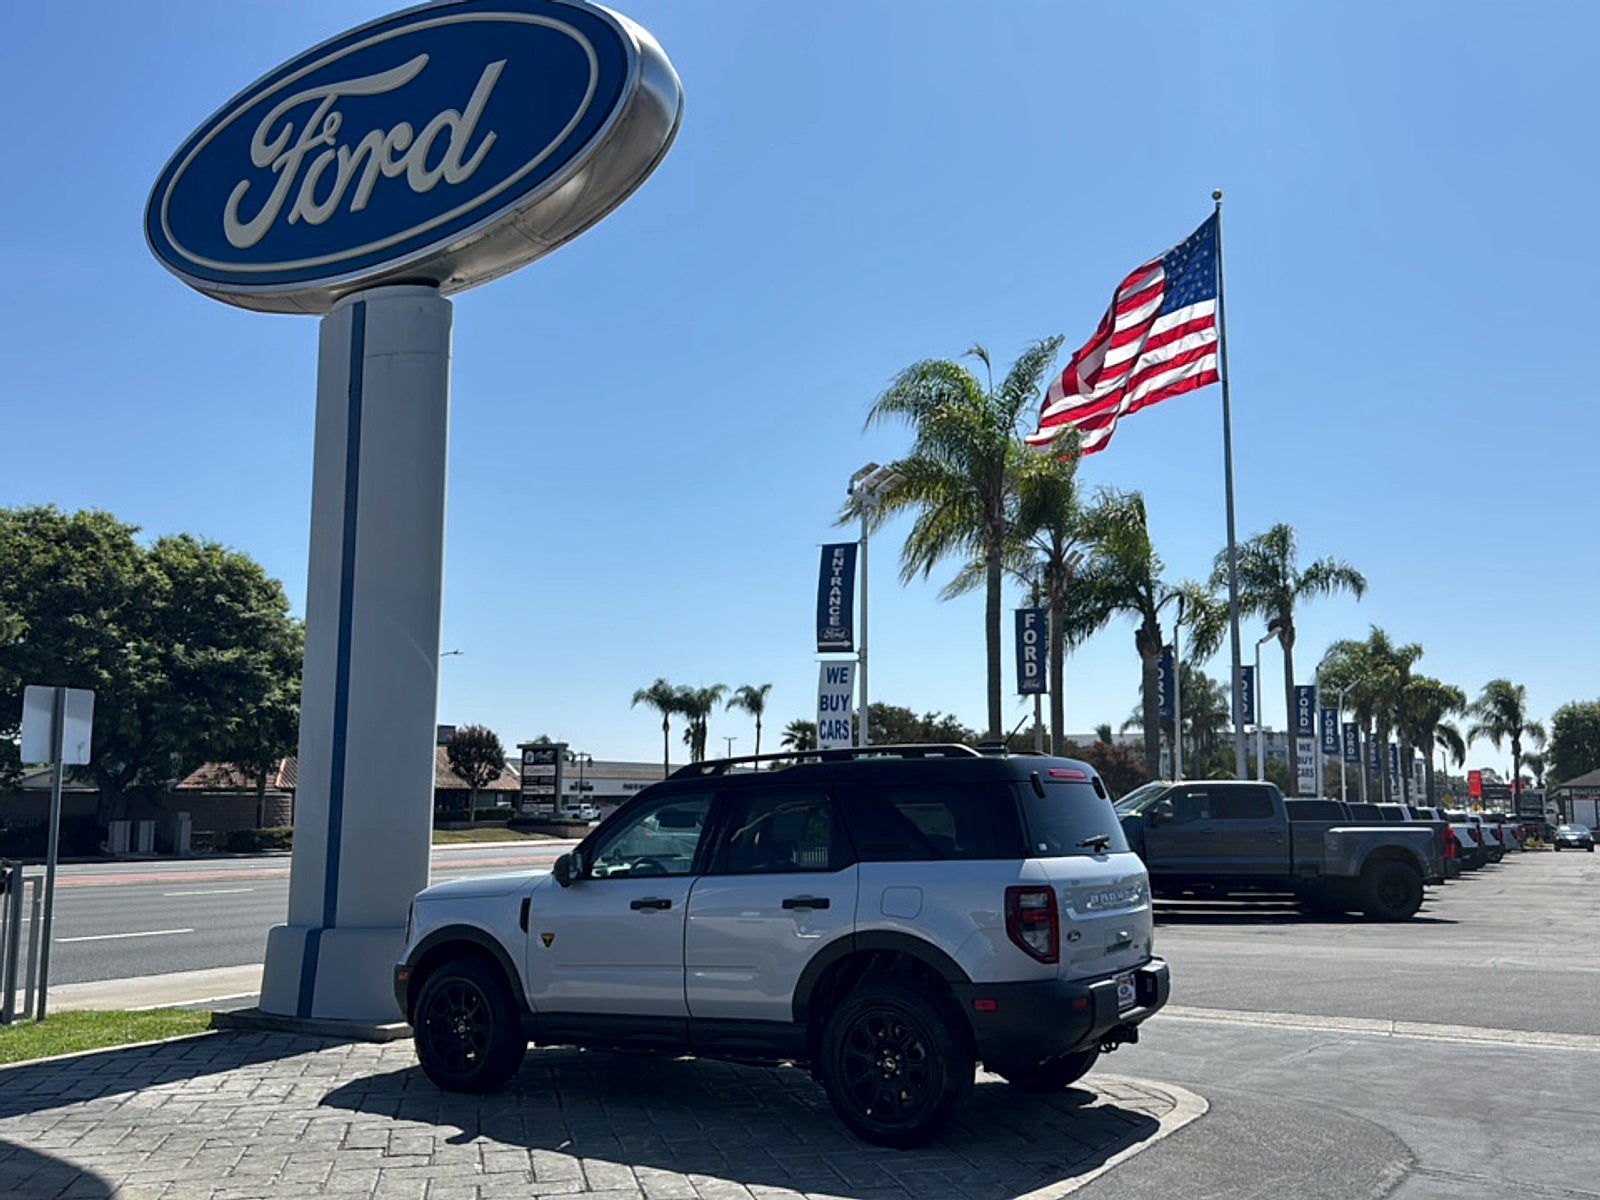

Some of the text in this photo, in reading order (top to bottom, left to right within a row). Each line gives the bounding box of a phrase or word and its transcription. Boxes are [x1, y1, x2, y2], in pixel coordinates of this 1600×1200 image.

[222, 53, 508, 249] Ford
[828, 548, 845, 626] ENTRANCE
[1023, 613, 1037, 677] FORD
[826, 667, 849, 684] WE
[820, 694, 850, 711] BUY
[1299, 688, 1309, 727] FORD
[819, 720, 849, 740] CARS
[1325, 710, 1334, 744] FORD
